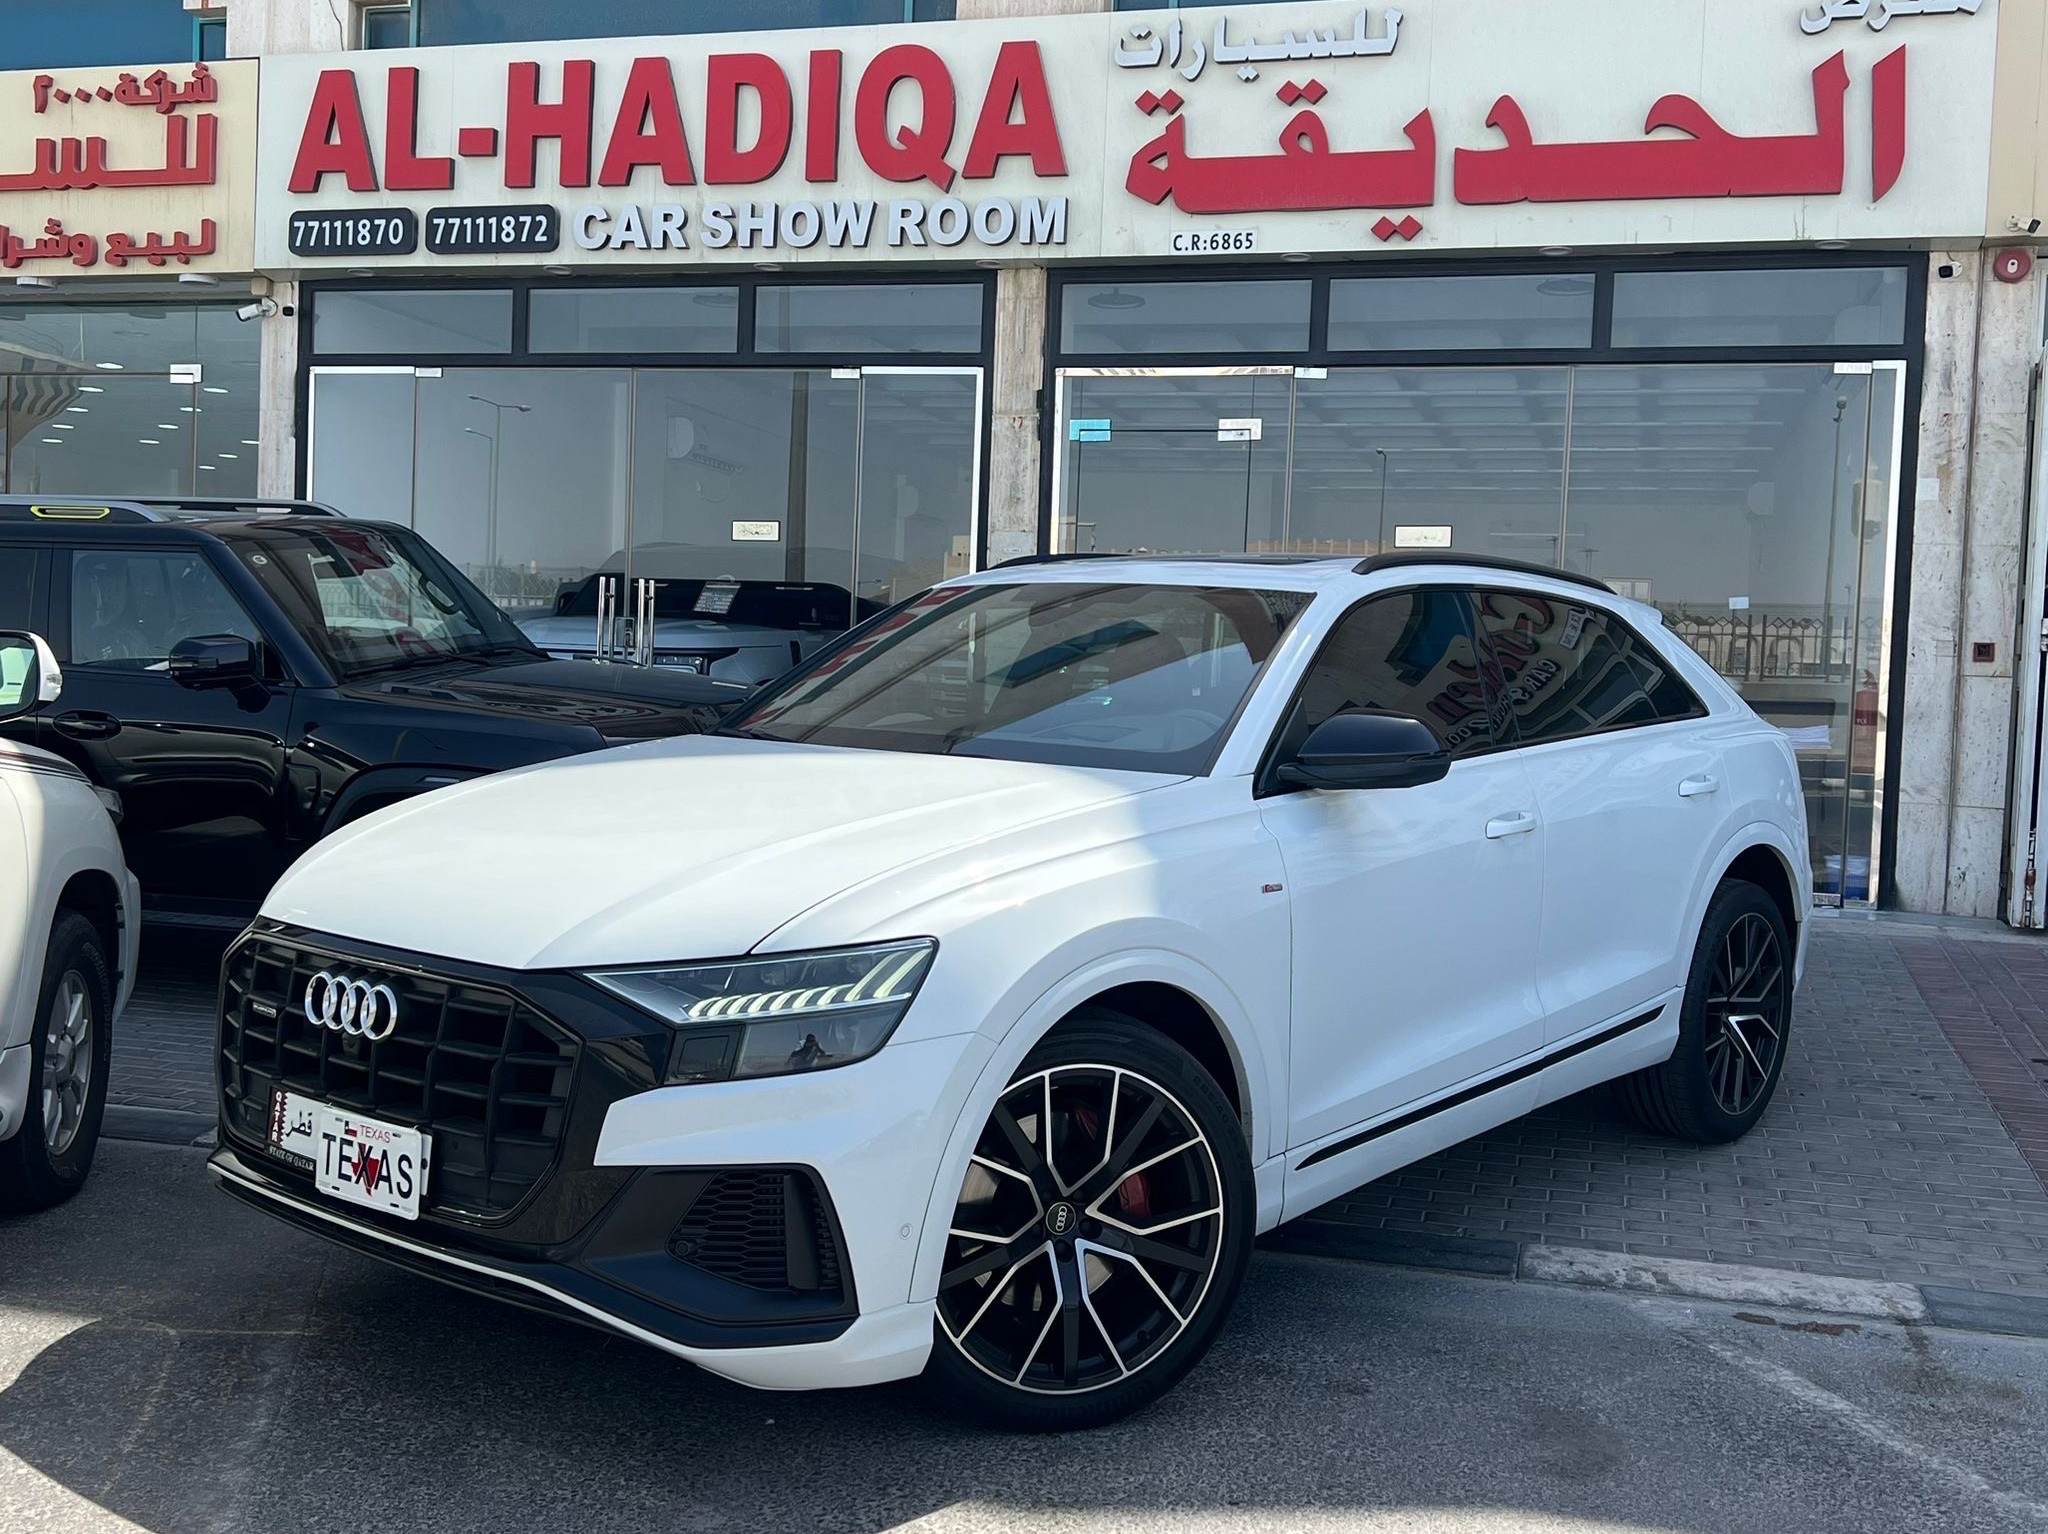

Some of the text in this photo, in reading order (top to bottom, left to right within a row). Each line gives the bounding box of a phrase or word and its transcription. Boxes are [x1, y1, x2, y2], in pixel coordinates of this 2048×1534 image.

[1114, 8, 1404, 82] للسيارات
[114, 61, 218, 114] شركة
[287, 39, 1069, 193] AL-HADIQA
[1126, 42, 1907, 242] الحديقة
[0, 113, 218, 190] للس
[105, 218, 217, 267] لبيع
[293, 217, 404, 247] 77111870
[432, 214, 548, 244] 77111872
[573, 197, 1069, 250] CAR SHOW ROOM
[1172, 232, 1254, 252] C.R:6865
[271, 1091, 283, 1142] QATAR
[285, 1110, 313, 1138] قطر
[359, 1124, 391, 1144] TEXAS
[322, 1132, 414, 1199] TEXAS
